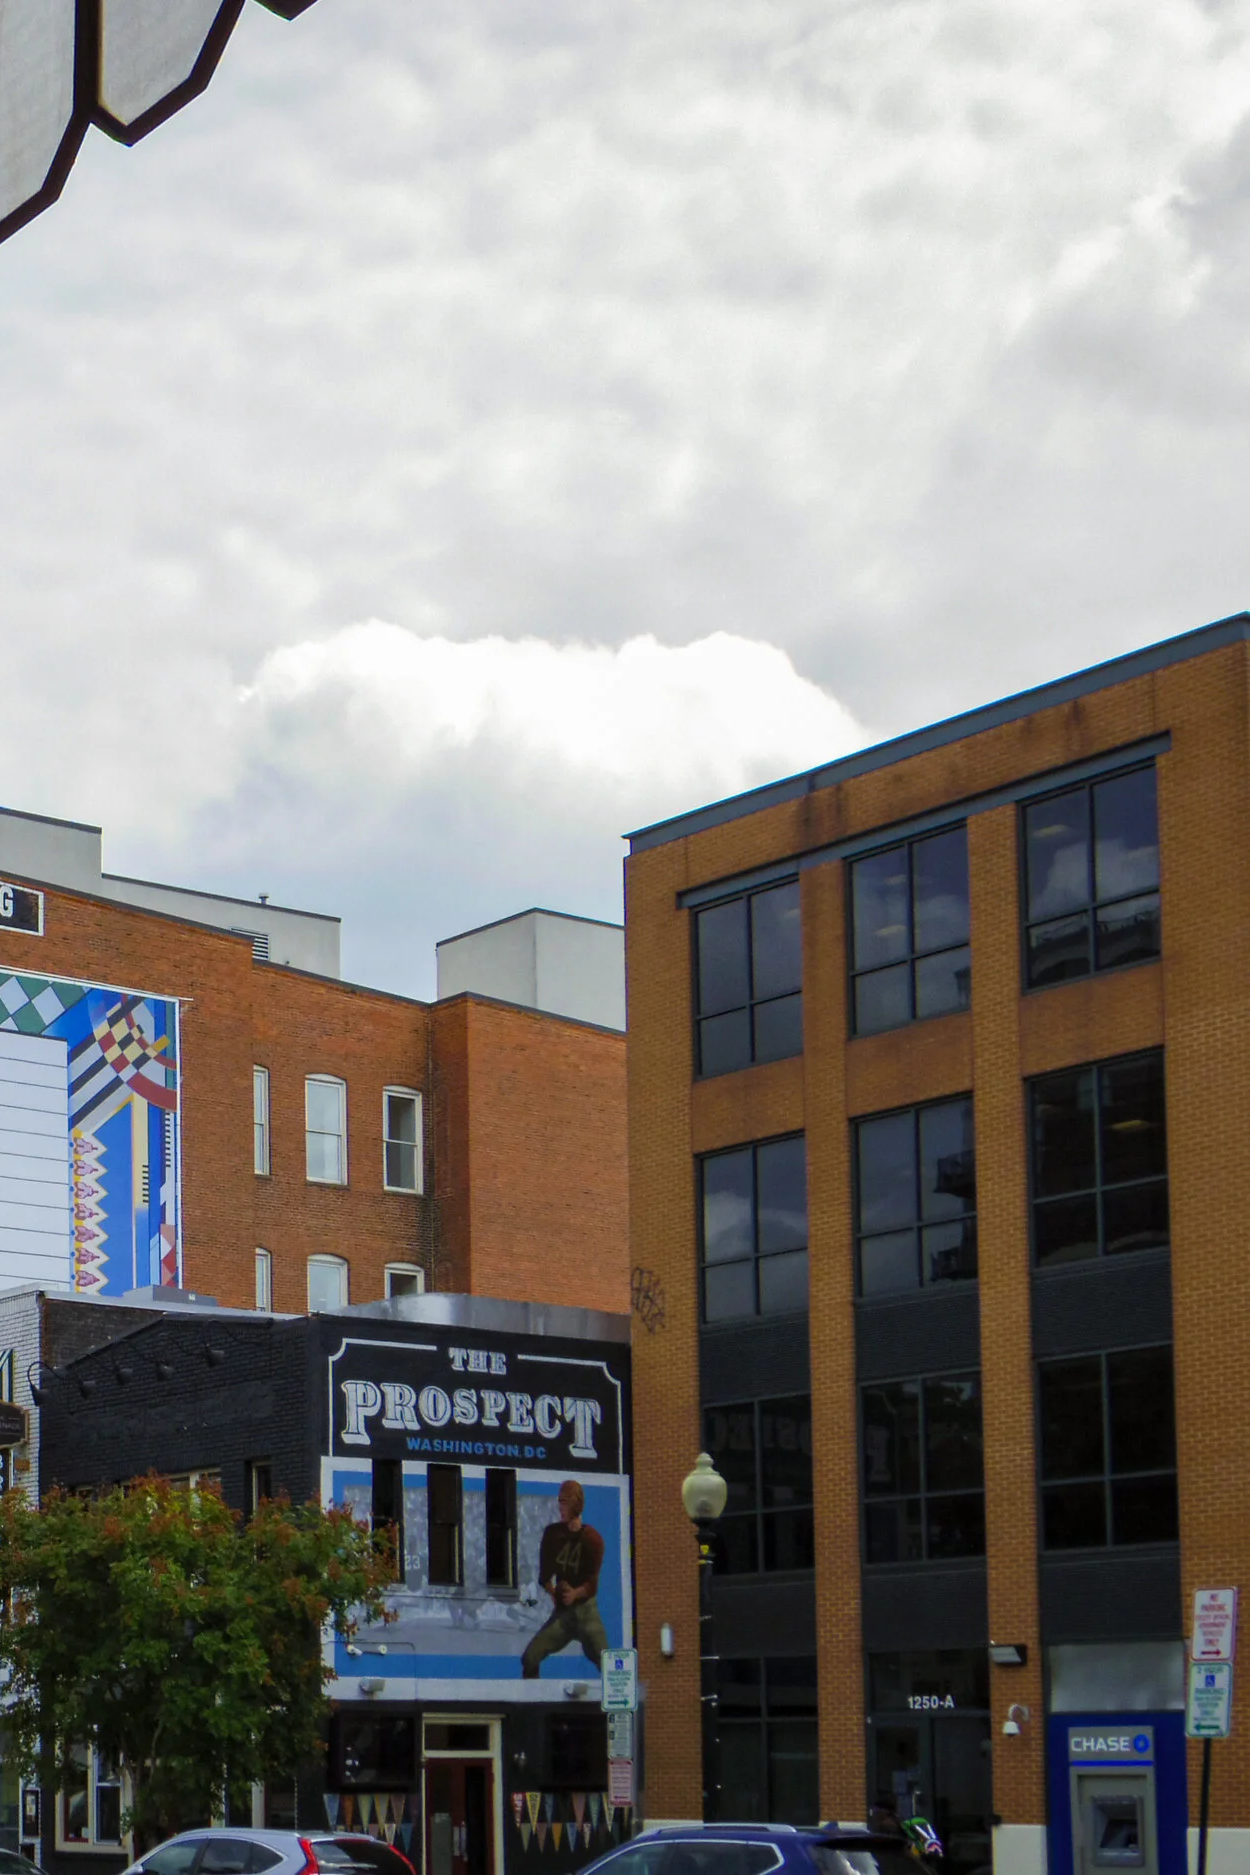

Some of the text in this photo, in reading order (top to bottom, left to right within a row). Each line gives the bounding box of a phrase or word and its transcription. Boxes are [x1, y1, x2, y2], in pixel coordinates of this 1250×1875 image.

[449, 1347, 507, 1375] THE
[341, 1380, 601, 1459] PROSPECT
[556, 1543, 583, 1575] 44
[907, 1694, 955, 1709] 1250-A
[1070, 1736, 1131, 1752] CHASE
